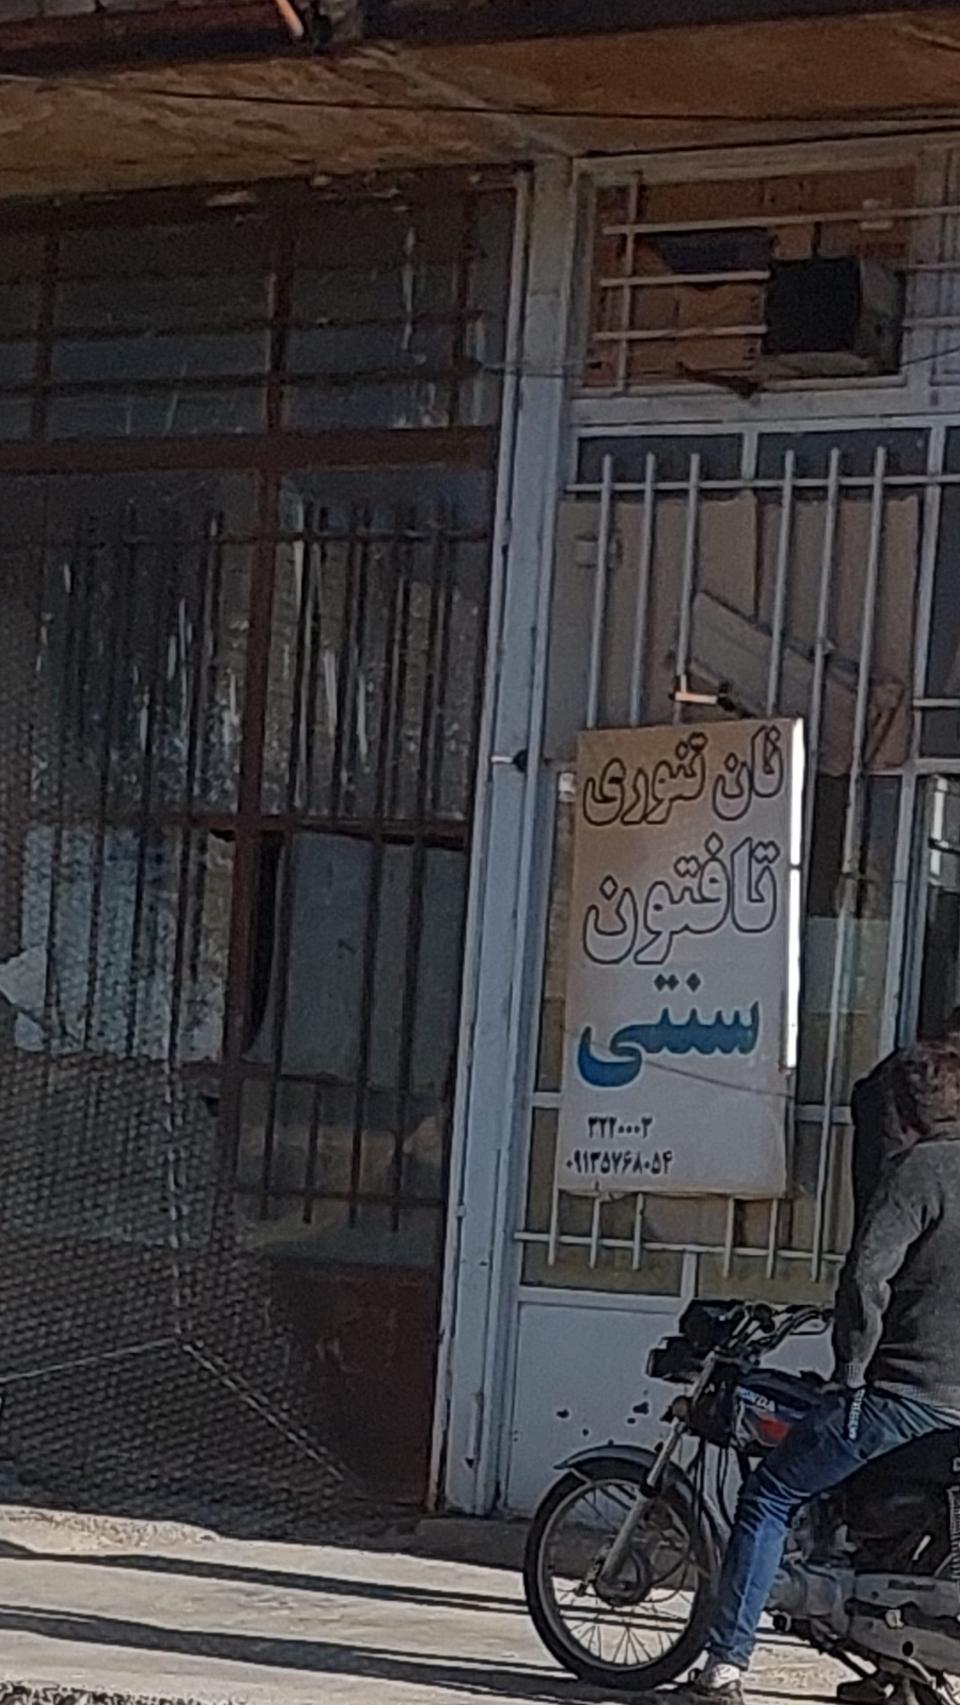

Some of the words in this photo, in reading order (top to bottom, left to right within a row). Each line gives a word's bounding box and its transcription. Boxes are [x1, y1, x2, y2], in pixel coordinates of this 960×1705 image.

[583, 731, 709, 826] تنوری
[712, 726, 784, 822] نان
[583, 831, 781, 966] تافتون
[578, 972, 760, 1089] سنتی
